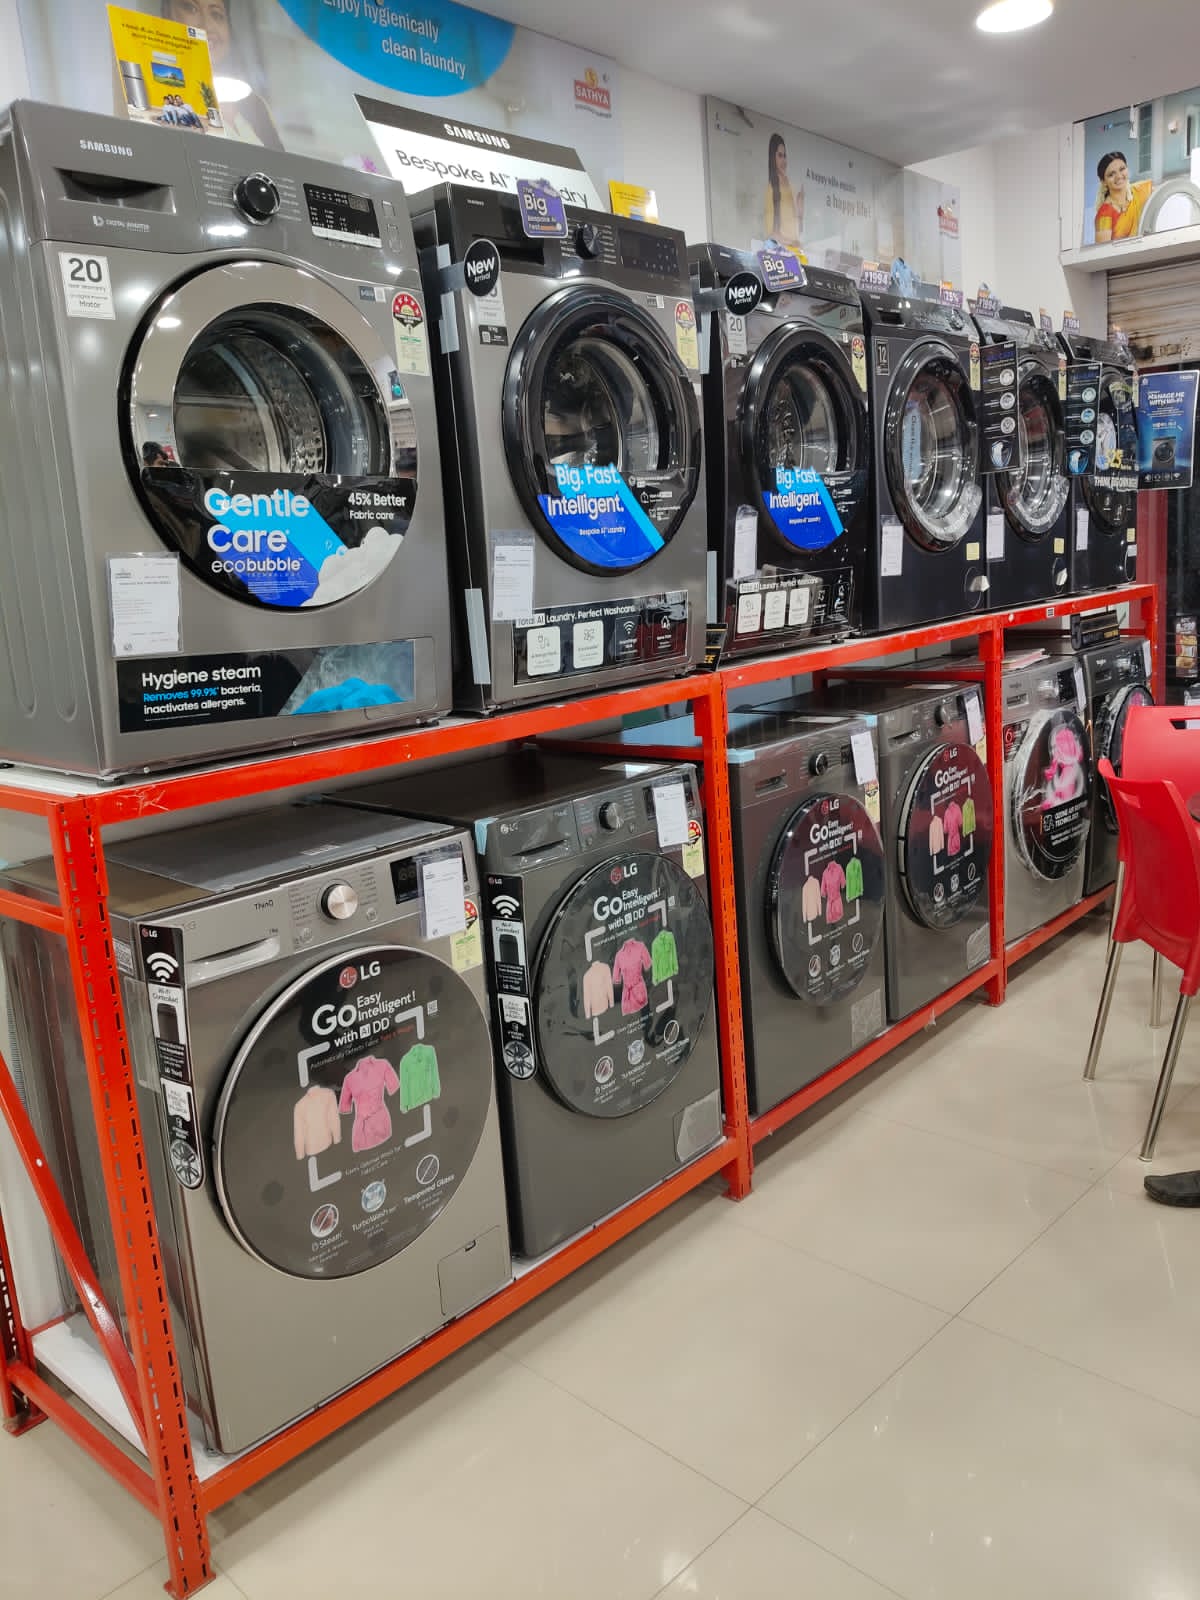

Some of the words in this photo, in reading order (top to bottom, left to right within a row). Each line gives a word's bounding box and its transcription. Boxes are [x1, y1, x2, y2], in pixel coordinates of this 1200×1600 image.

[364, 4, 439, 43] hygienically
[382, 37, 417, 62] clean
[420, 48, 466, 80] laundry
[575, 85, 610, 105] SATHYA
[444, 123, 510, 149] SAMSUNG
[79, 139, 133, 157] SAMSUNG
[395, 149, 484, 183] Bespoke
[524, 193, 547, 215] Big
[832, 194, 855, 217] happy
[68, 257, 102, 283] 20
[466, 256, 495, 278] New
[764, 258, 785, 273] Big
[728, 284, 758, 300] New
[730, 316, 742, 332] 20
[556, 466, 584, 491] Big.
[586, 464, 621, 485] Fast.
[204, 487, 310, 518] Gentle
[348, 492, 371, 506] 45%
[373, 493, 407, 507] Better
[547, 492, 625, 520] Intelligent.
[349, 510, 374, 520] Fabric
[375, 512, 395, 520] care
[579, 528, 600, 536] Bespoke
[546, 613, 577, 625] Laundry.
[578, 609, 603, 619] Perfect
[142, 669, 209, 690] Hygiene
[212, 666, 261, 681] steam
[143, 690, 189, 702] Removes
[143, 702, 199, 715] inactivates
[200, 697, 247, 710] allergens.
[949, 747, 958, 759] LG
[830, 799, 840, 811] LG
[624, 862, 638, 878] LG
[622, 888, 638, 900] Easy
[254, 900, 274, 910] ThinQ
[608, 917, 624, 931] with
[149, 929, 158, 938] LG
[360, 960, 381, 981] LG
[357, 991, 382, 1009] Easy
[334, 1029, 359, 1047] with
[403, 1182, 436, 1205] Tempered
[437, 1173, 455, 1188] Glass
